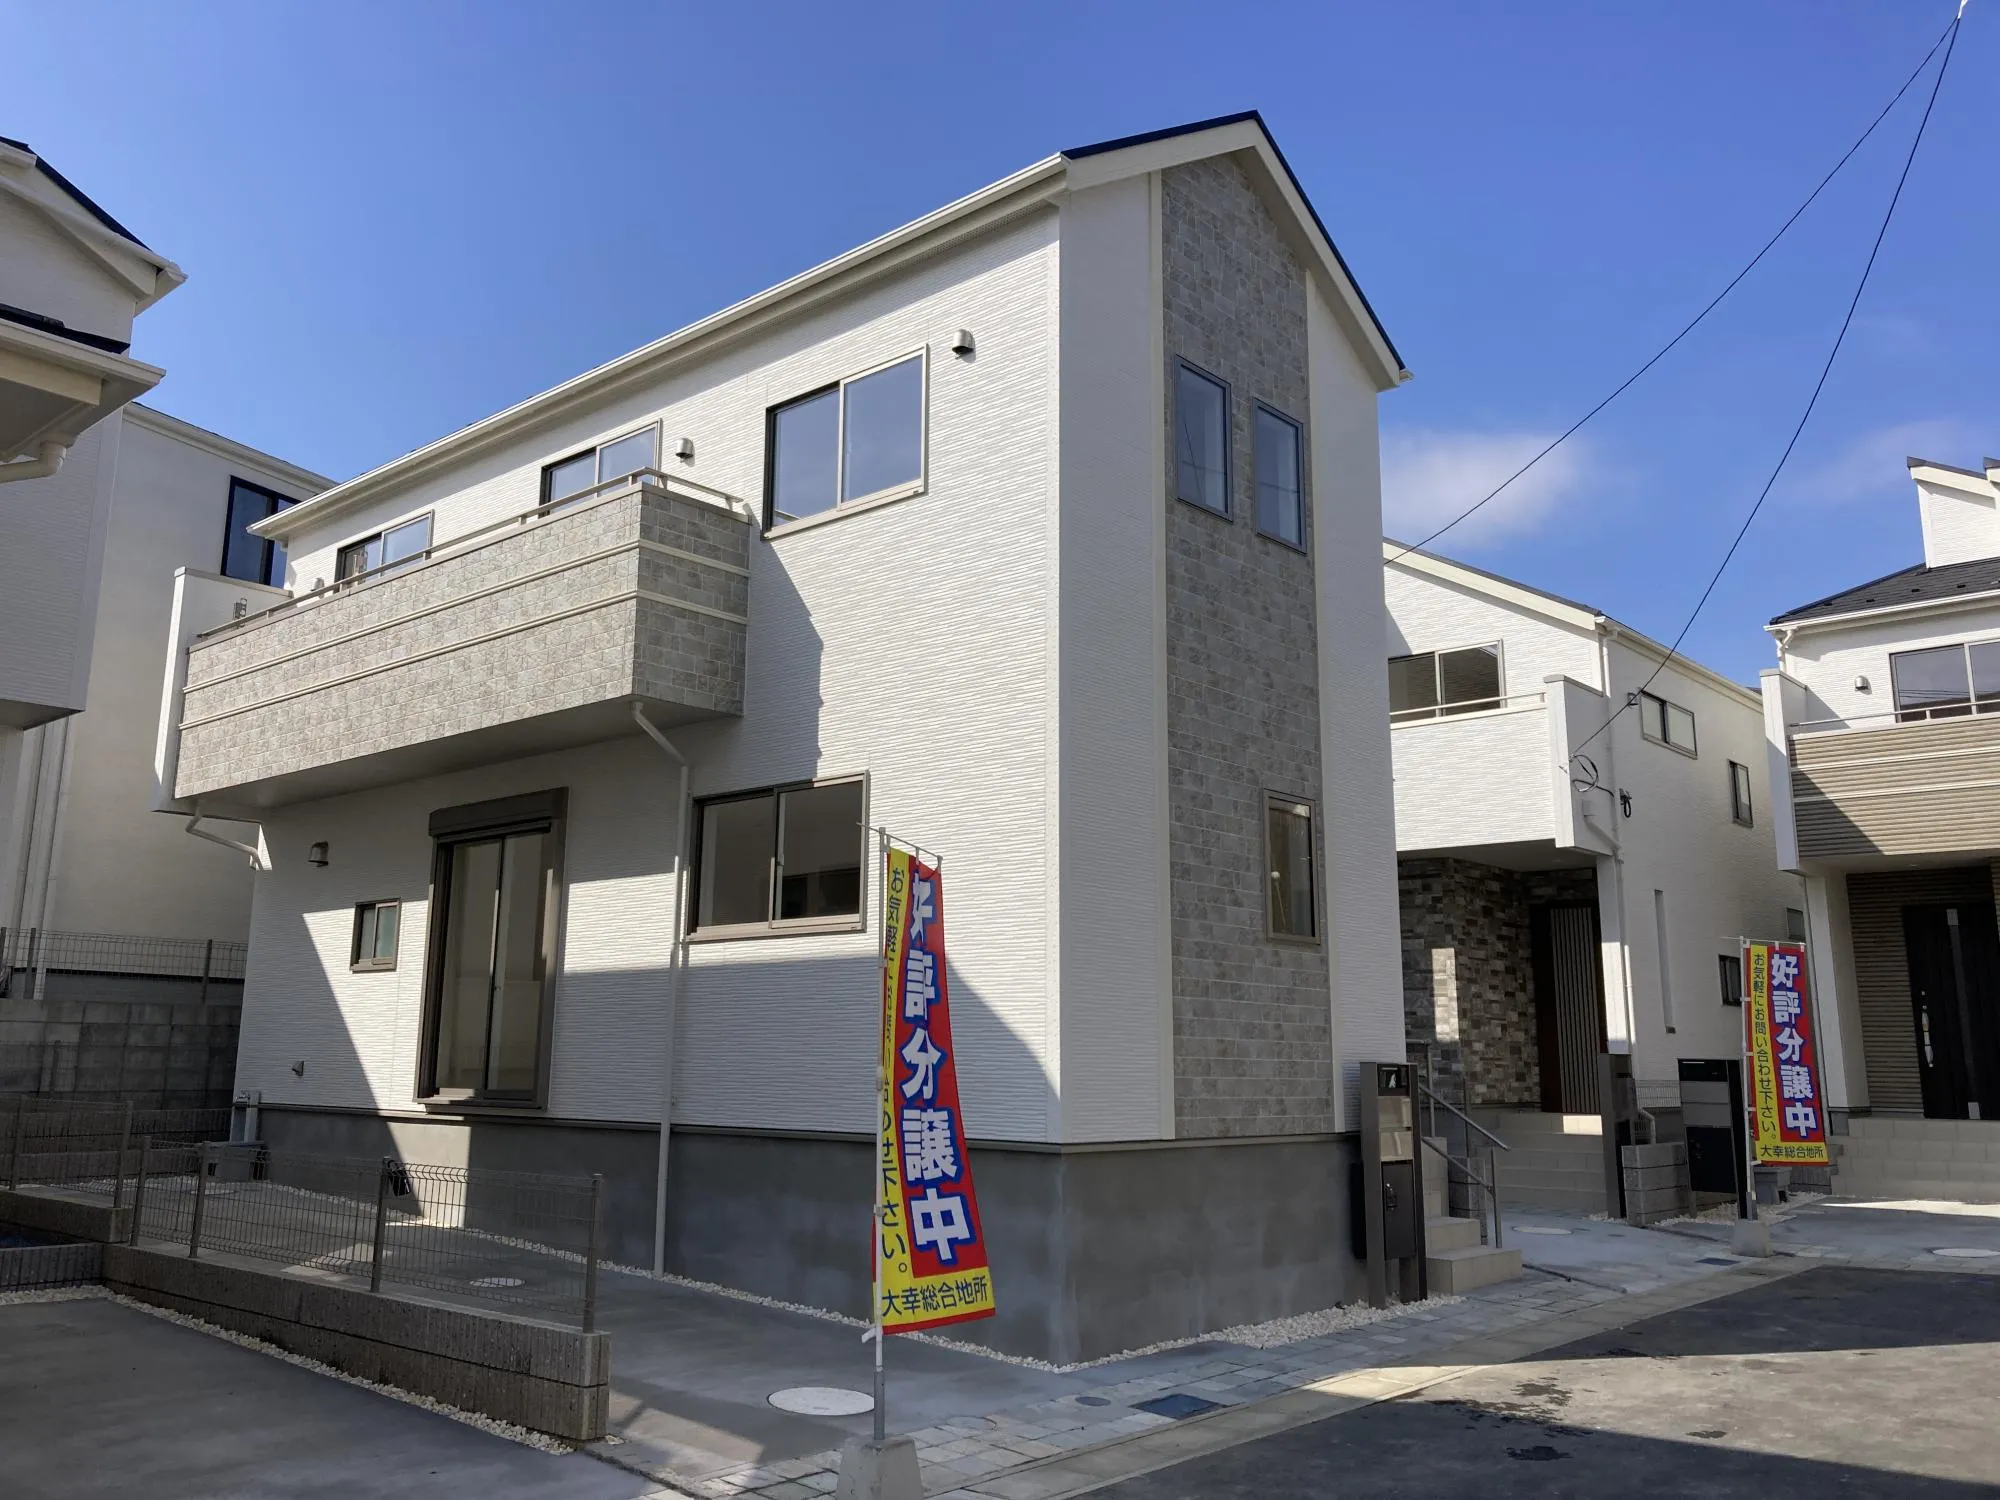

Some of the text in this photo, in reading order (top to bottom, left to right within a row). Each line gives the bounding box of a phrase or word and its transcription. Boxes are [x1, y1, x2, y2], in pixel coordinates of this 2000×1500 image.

[1752, 953, 1777, 1139] お気軽にお問い合わせ下さい。
[1771, 953, 1817, 1137] 好評分譲中
[1761, 1144, 1824, 1159] 大幸総合地所
[882, 1275, 988, 1317] 大幸総合地所
